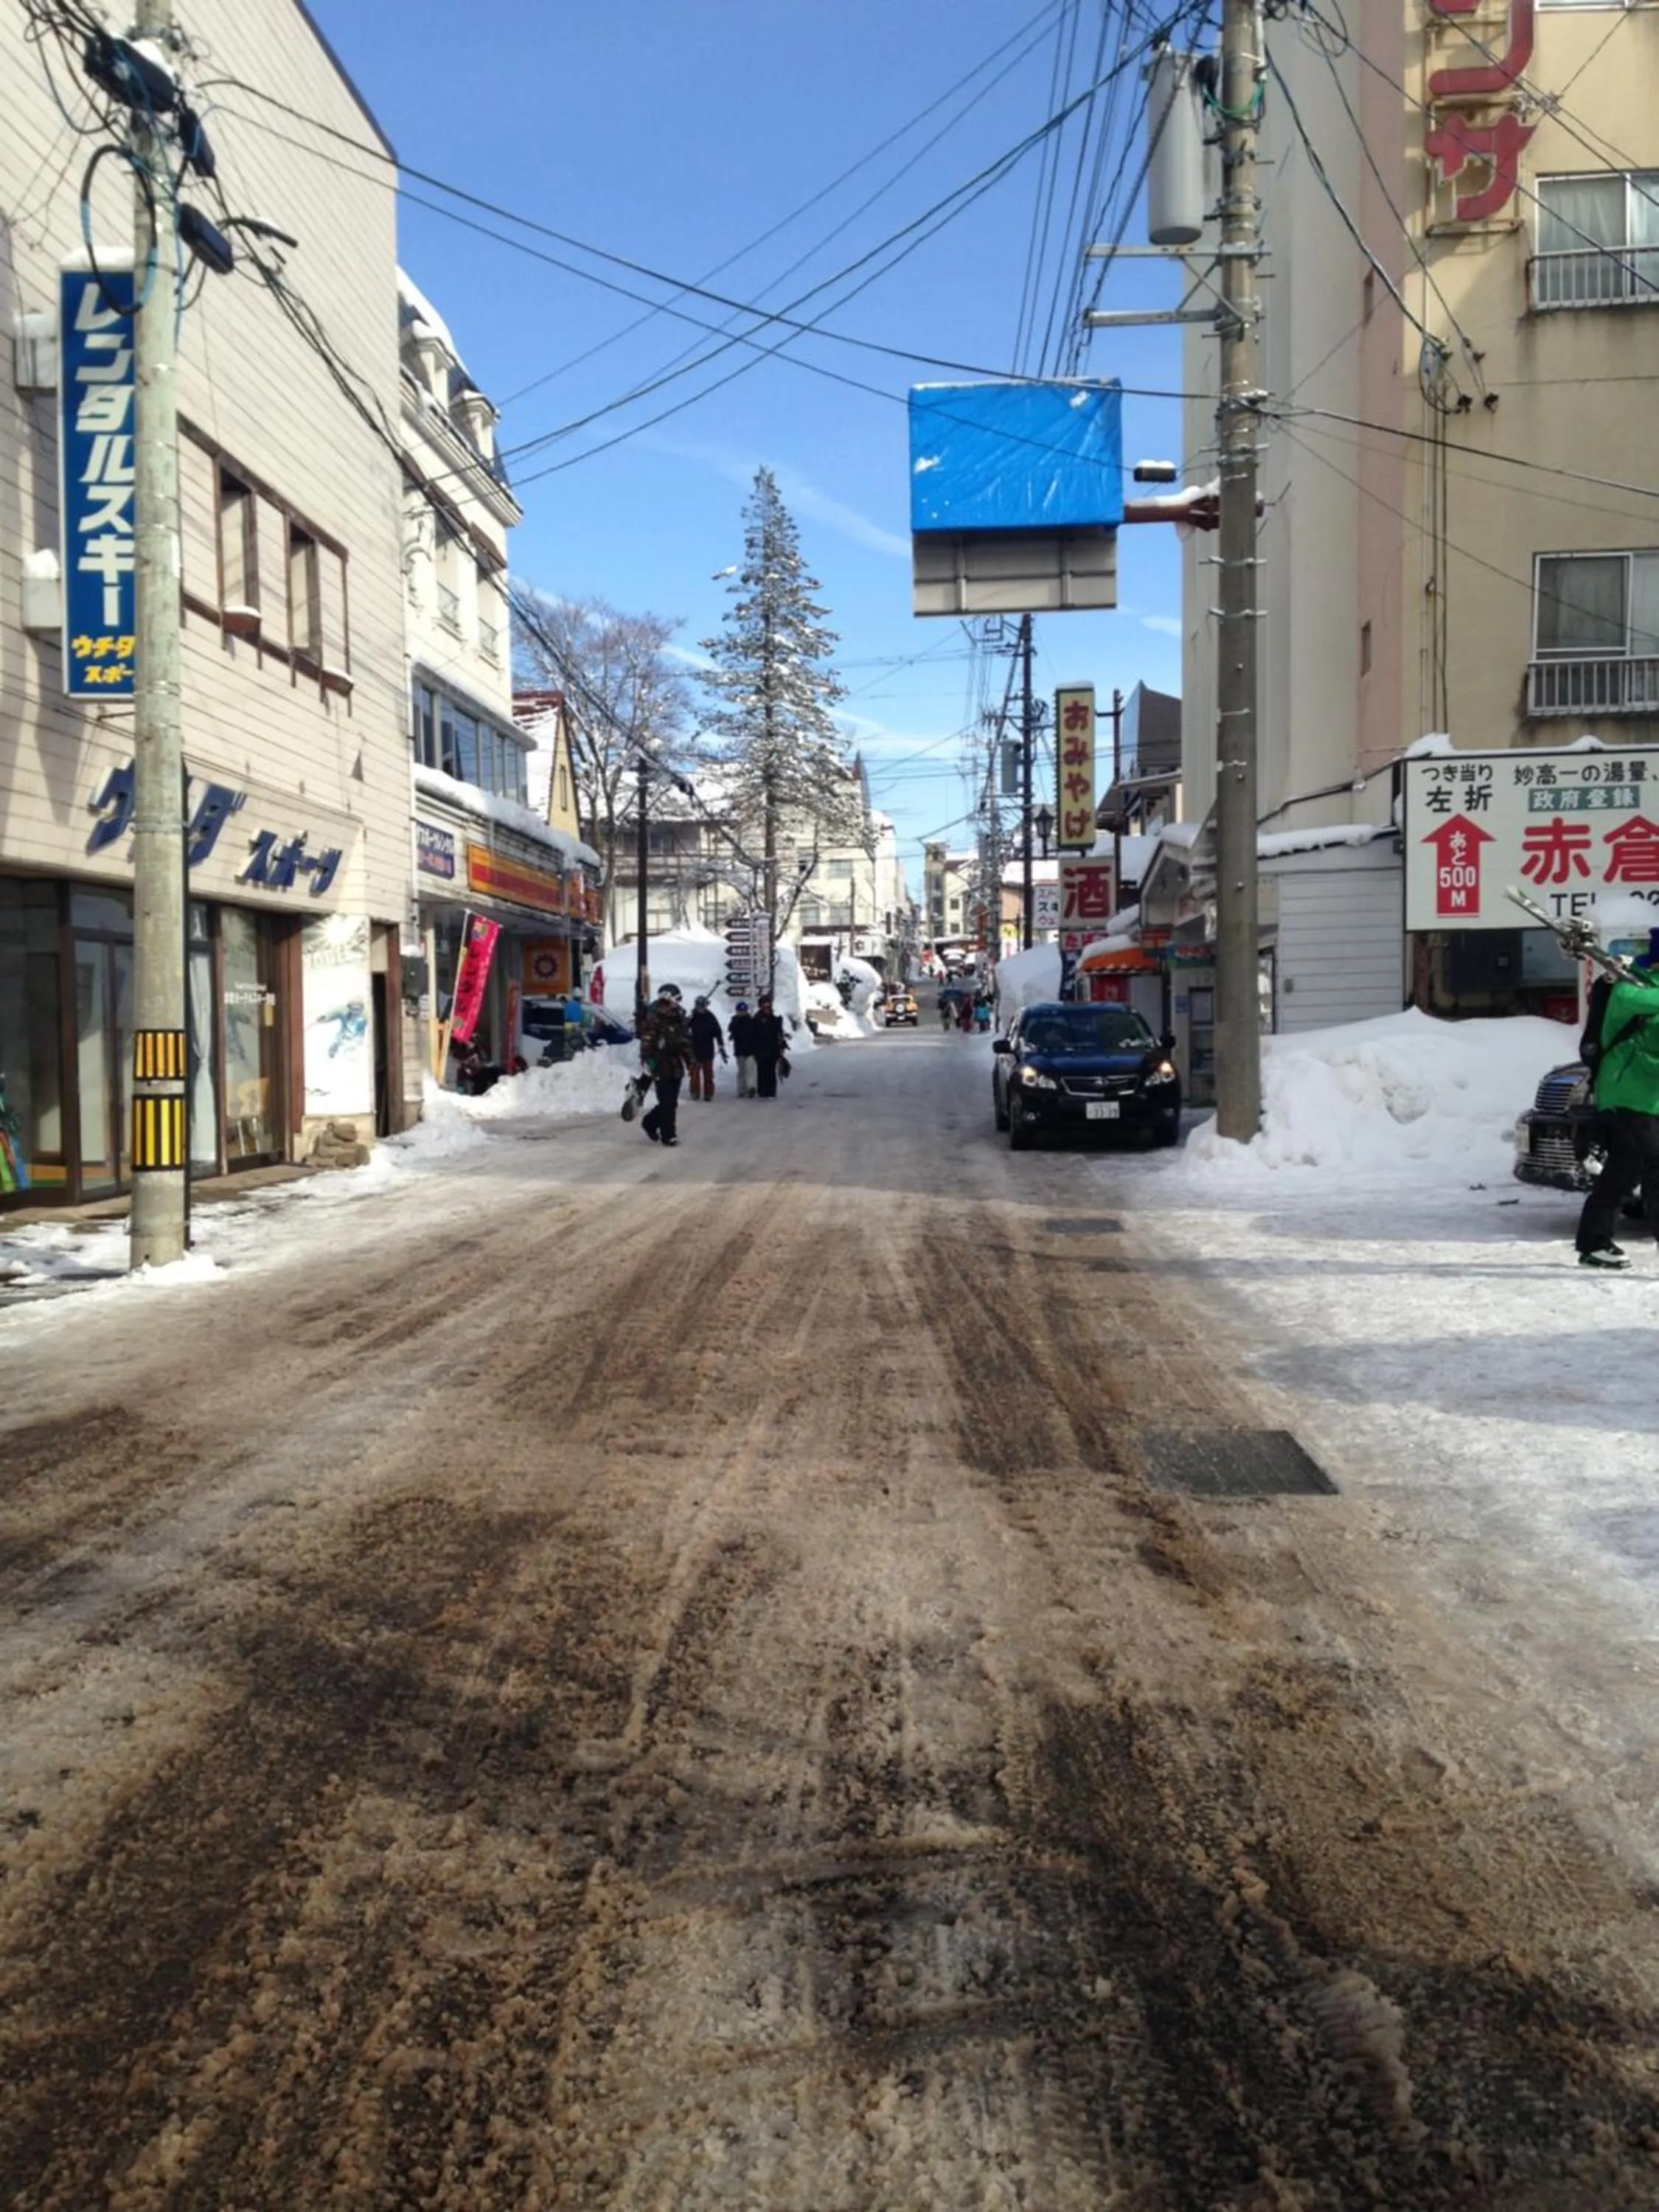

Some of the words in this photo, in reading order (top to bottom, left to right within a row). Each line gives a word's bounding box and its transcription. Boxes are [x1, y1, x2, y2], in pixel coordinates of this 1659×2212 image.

[74, 282, 136, 627] レンタルスキー
[83, 663, 134, 684] スポー
[1421, 763, 1494, 782] つき当り
[1513, 760, 1659, 786] 妙高一の湯量、
[1425, 785, 1493, 812] 左折
[1533, 787, 1635, 810] 政府登録
[86, 757, 248, 869] ウダ
[235, 828, 343, 897] スポーツ
[1449, 831, 1467, 865] あと
[1520, 814, 1659, 885] 赤倉
[1439, 867, 1475, 888] 500
[1063, 866, 1111, 919] 酒
[1450, 891, 1466, 907] M
